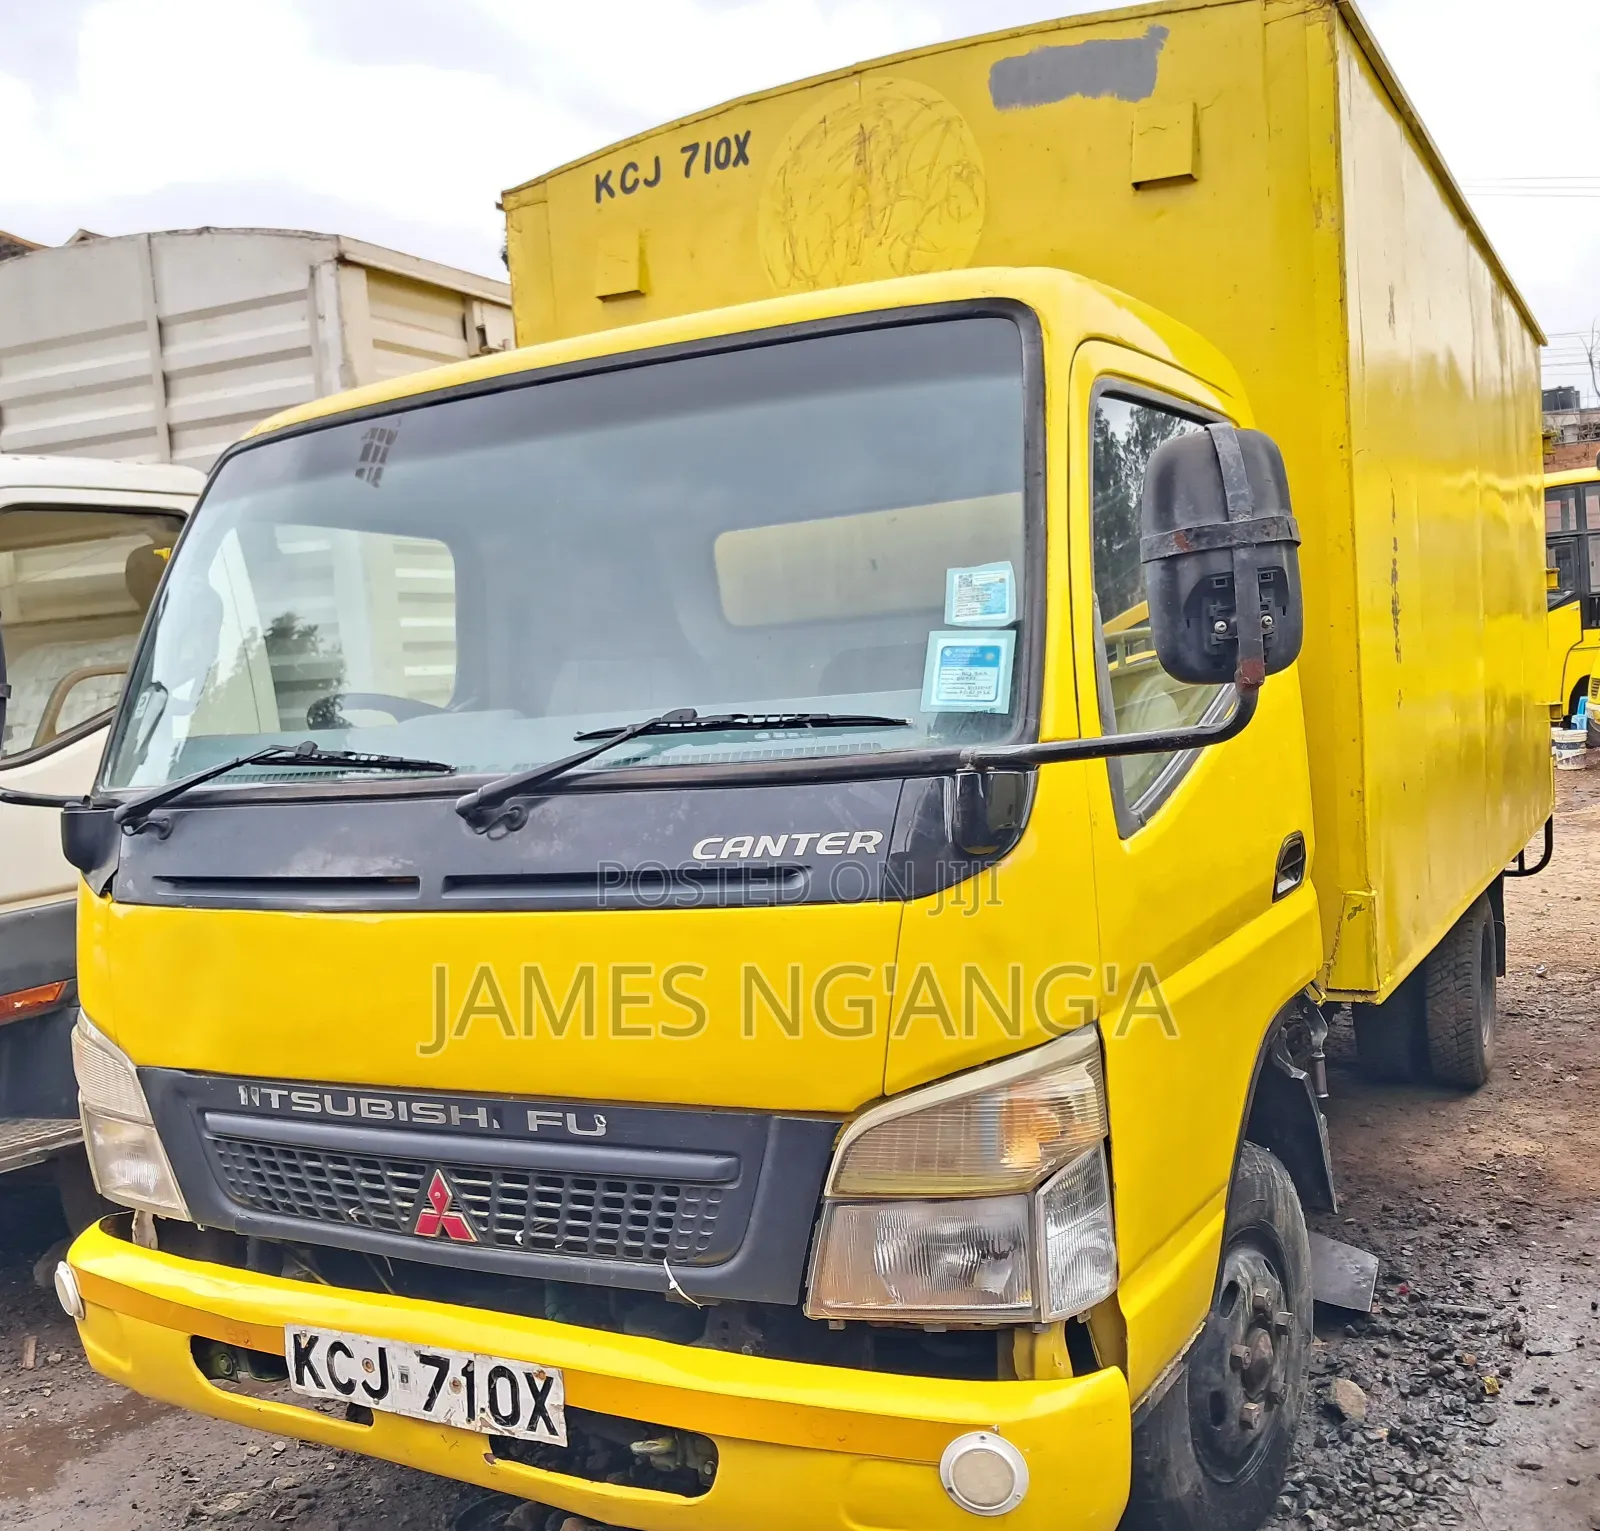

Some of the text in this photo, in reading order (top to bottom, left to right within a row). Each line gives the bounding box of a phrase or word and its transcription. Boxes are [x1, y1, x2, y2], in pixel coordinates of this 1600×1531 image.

[595, 130, 751, 203] KCJ 710X
[693, 830, 884, 860] CANTER
[293, 1333, 559, 1436] KCJ 710X
